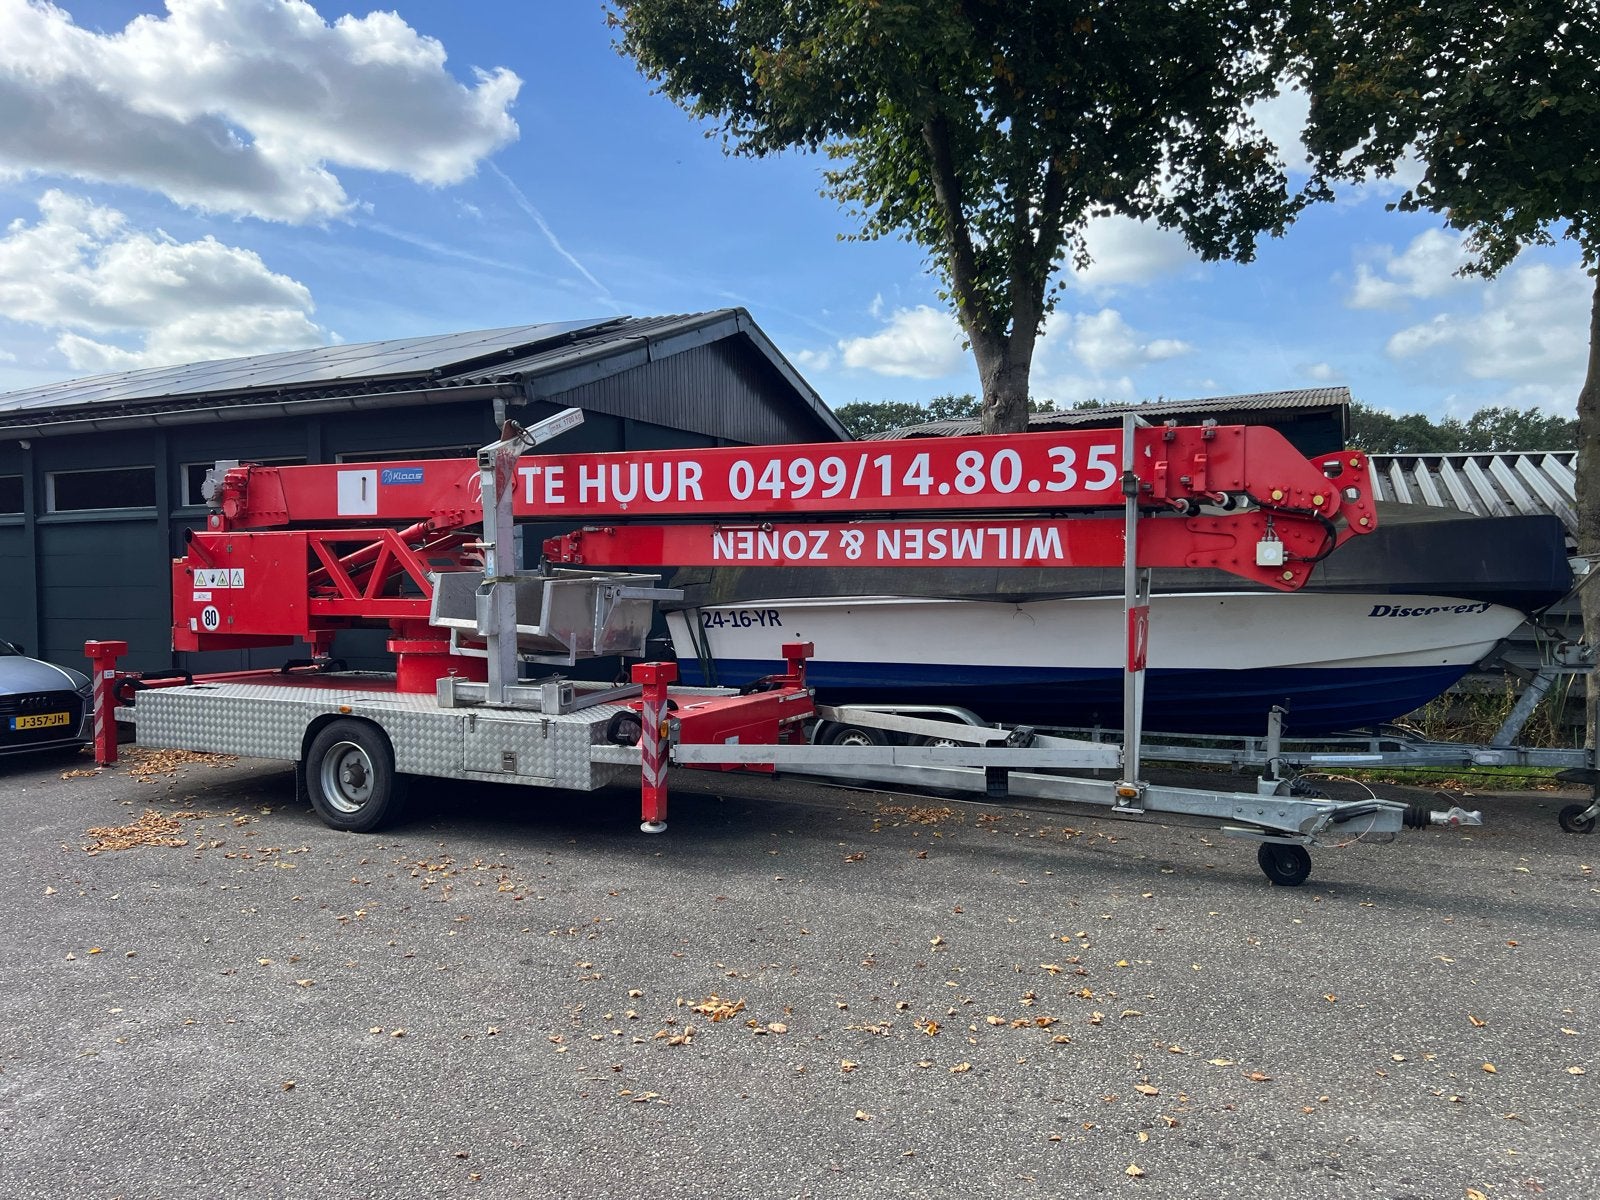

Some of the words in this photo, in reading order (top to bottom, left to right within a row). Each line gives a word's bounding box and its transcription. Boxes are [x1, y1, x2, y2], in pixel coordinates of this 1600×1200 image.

[392, 472, 423, 480] Klaas
[518, 465, 565, 504] TE
[579, 461, 704, 503] HUUR
[728, 444, 1117, 500] 0499/14.80.35
[713, 530, 830, 560] ZONEN
[839, 529, 865, 560] &
[876, 527, 1064, 560] WILMSEN
[204, 609, 217, 627] 80
[701, 609, 783, 629] 24-16-YR
[20, 715, 65, 728] J-357-JH
